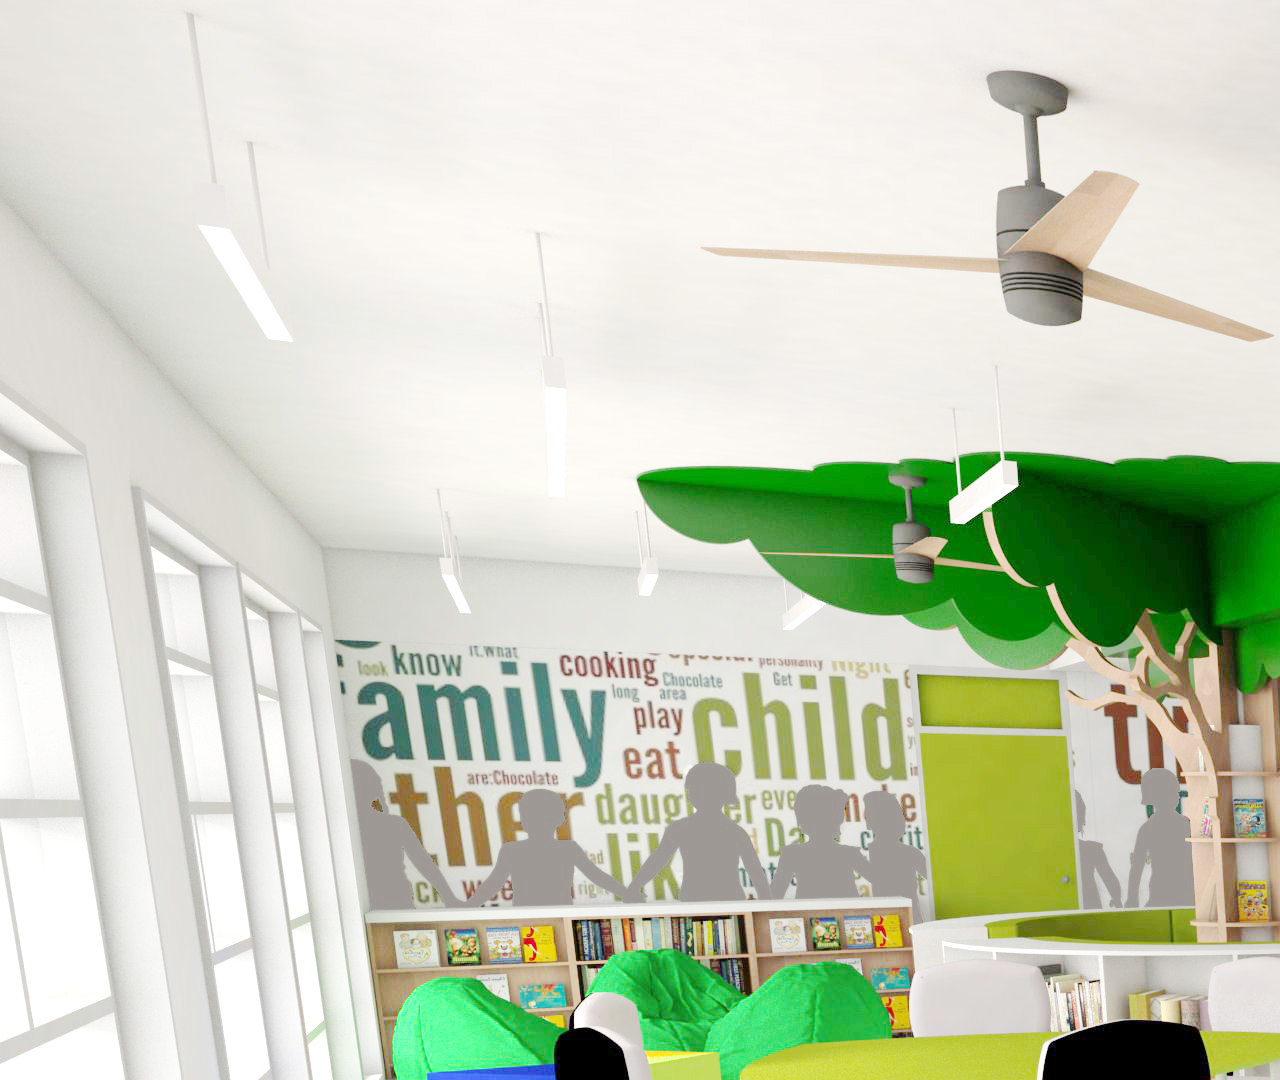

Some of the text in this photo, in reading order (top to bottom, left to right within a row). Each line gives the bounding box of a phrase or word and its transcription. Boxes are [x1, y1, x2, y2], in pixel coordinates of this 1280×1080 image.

[357, 660, 389, 677] look
[391, 645, 462, 677] know
[560, 651, 659, 687] cooking
[611, 683, 640, 703] long
[659, 688, 687, 701] area
[662, 671, 724, 688] Chocolate
[773, 671, 793, 687] Get
[340, 661, 606, 788] amily
[633, 700, 683, 735] play
[692, 672, 908, 782] child
[624, 741, 683, 780] eat
[467, 769, 559, 786] are:Chocolate
[596, 783, 757, 825] dauger
